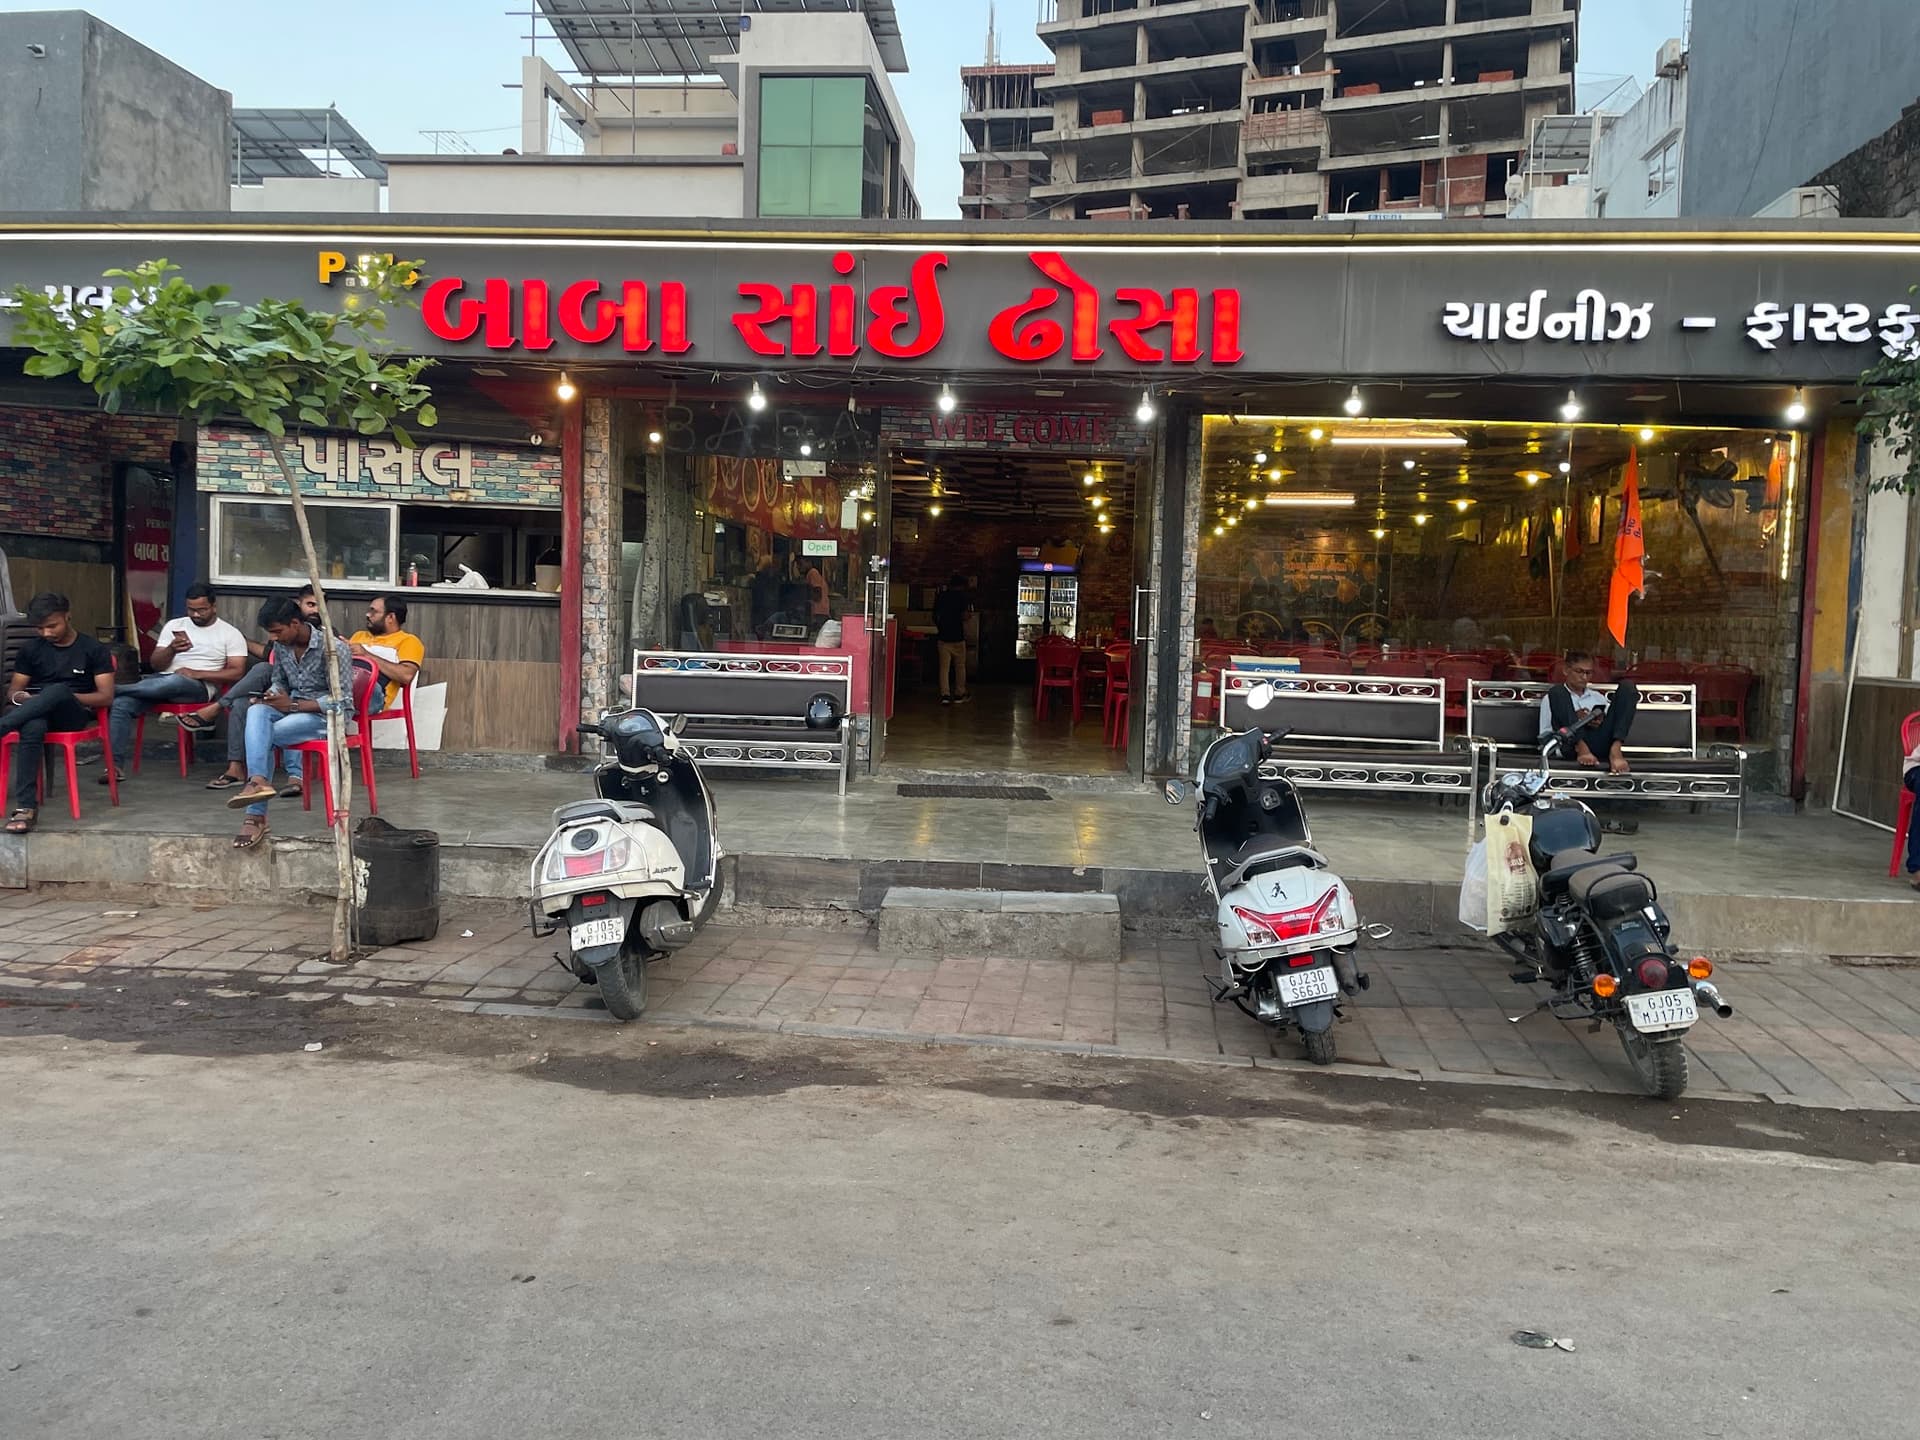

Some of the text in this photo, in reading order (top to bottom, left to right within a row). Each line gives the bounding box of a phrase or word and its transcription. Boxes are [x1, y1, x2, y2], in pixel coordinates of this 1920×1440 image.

[421, 251, 1244, 362] બાબા સાંઈ ઢોસા
[1443, 289, 1653, 340] ચાઈનીઝ
[134, 543, 158, 561] બાબા
[807, 542, 833, 552] Open
[587, 920, 614, 934] GJ05
[1289, 969, 1325, 988] GJ23D
[1292, 982, 1328, 999] S6630
[1648, 994, 1682, 1009] GJ05
[1642, 1007, 1693, 1024] MJ1779
